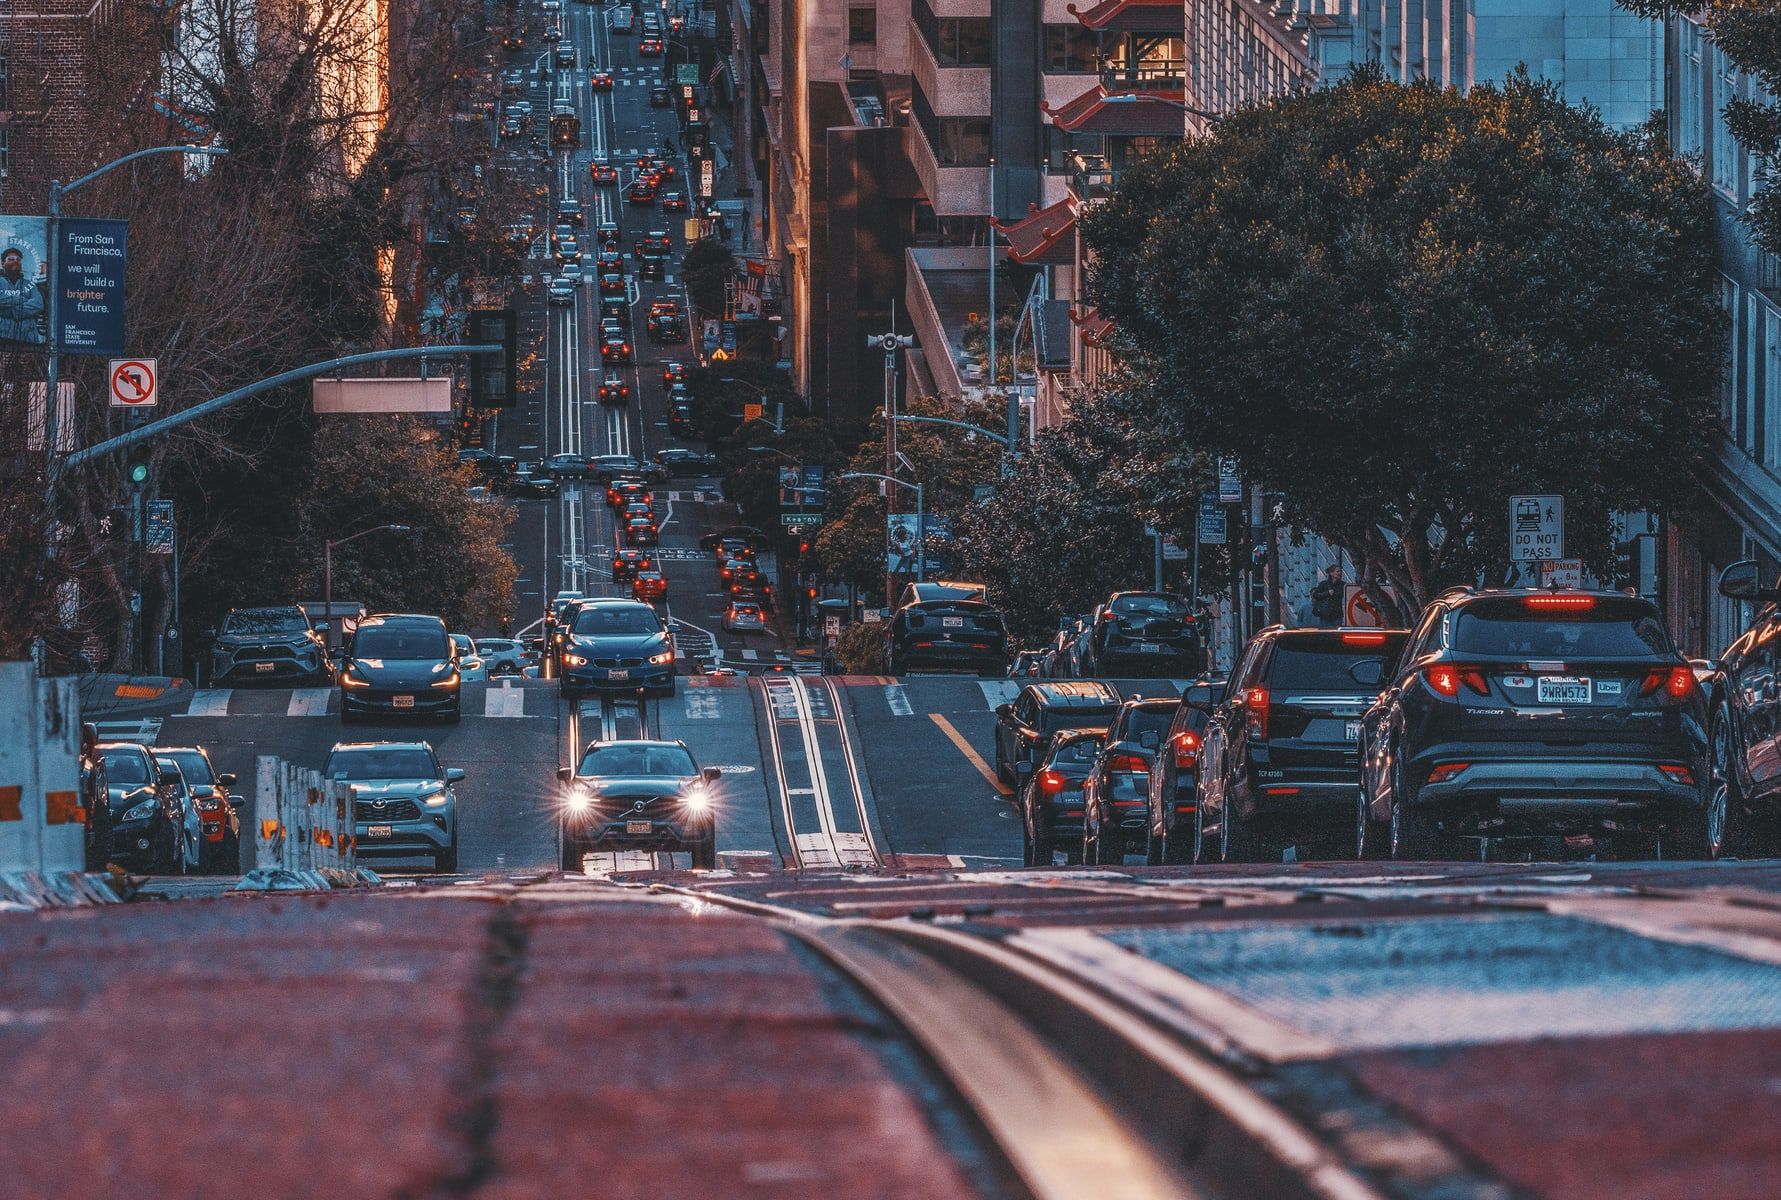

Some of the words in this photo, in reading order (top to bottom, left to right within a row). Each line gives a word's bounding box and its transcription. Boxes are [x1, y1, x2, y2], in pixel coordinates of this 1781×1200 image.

[68, 233, 93, 244] From
[95, 234, 114, 245] San
[74, 245, 122, 257] Francisco,
[67, 265, 82, 273] we
[83, 264, 100, 274] will
[84, 277, 107, 287] build
[108, 280, 115, 288] a
[66, 289, 106, 301] brighter
[77, 303, 110, 313] future.
[1516, 535, 1531, 545] DO
[1536, 534, 1558, 545] NOT
[1523, 547, 1552, 558] PASS
[1543, 561, 1554, 572] NO
[1555, 562, 1580, 571] PARKING
[1542, 686, 1588, 699] 9WRW573
[1600, 683, 1619, 692] Uber
